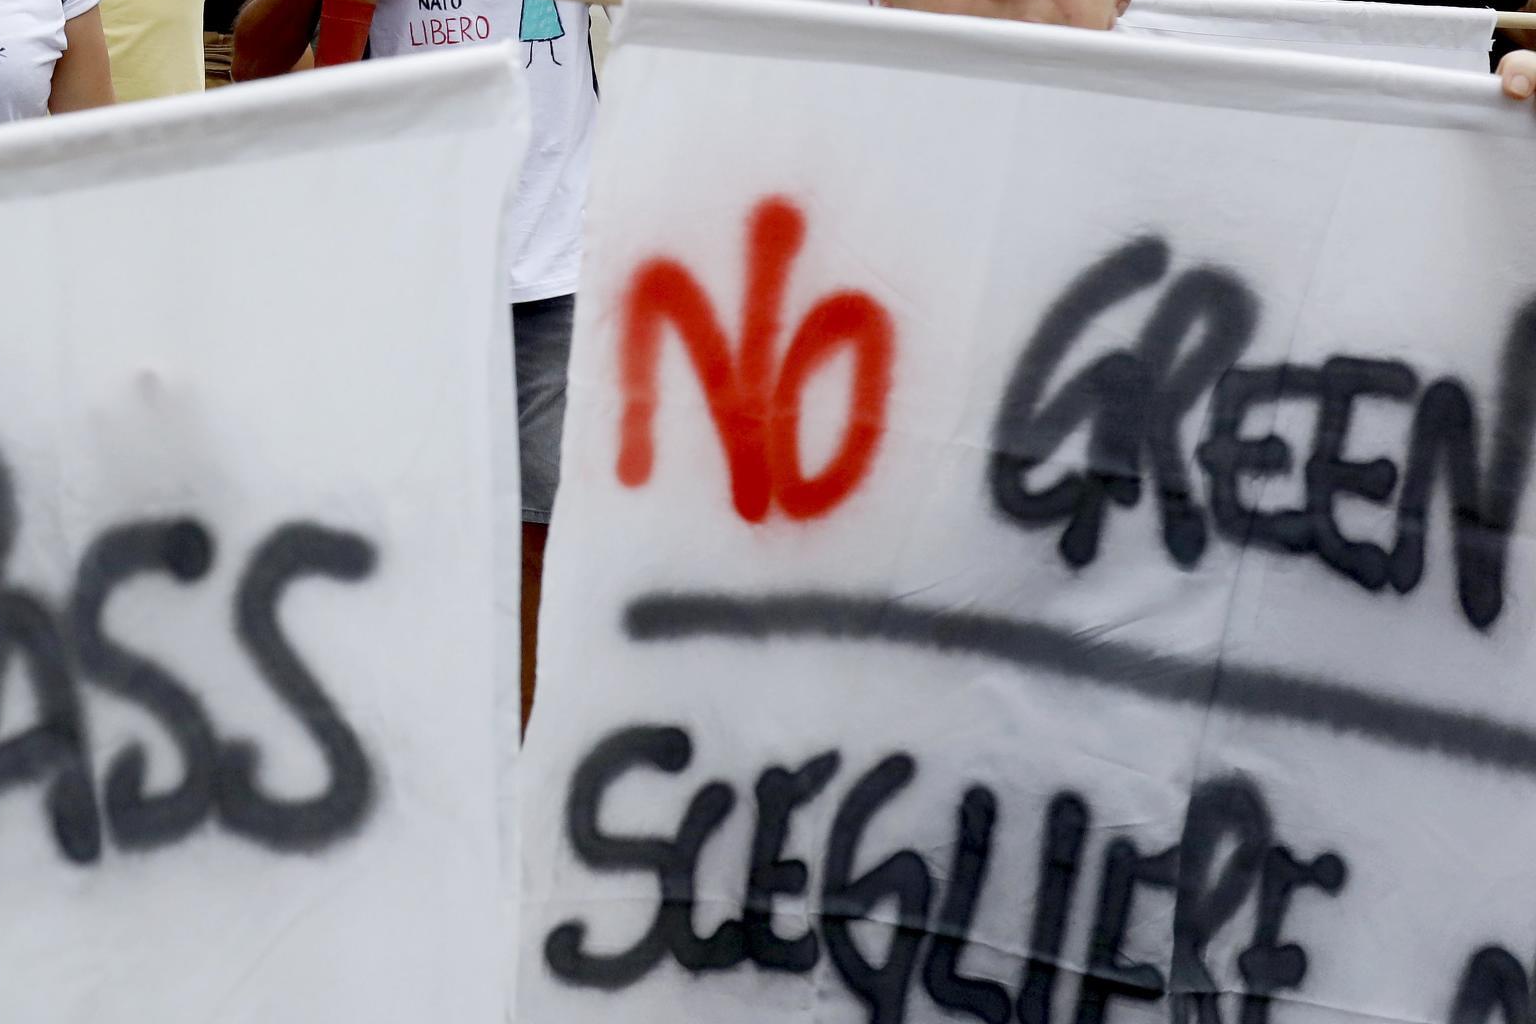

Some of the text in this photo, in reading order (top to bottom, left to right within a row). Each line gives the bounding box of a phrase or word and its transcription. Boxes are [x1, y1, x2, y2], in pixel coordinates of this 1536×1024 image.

[408, 15, 490, 47] LIBERO
[614, 193, 1536, 632] NO GREEN
